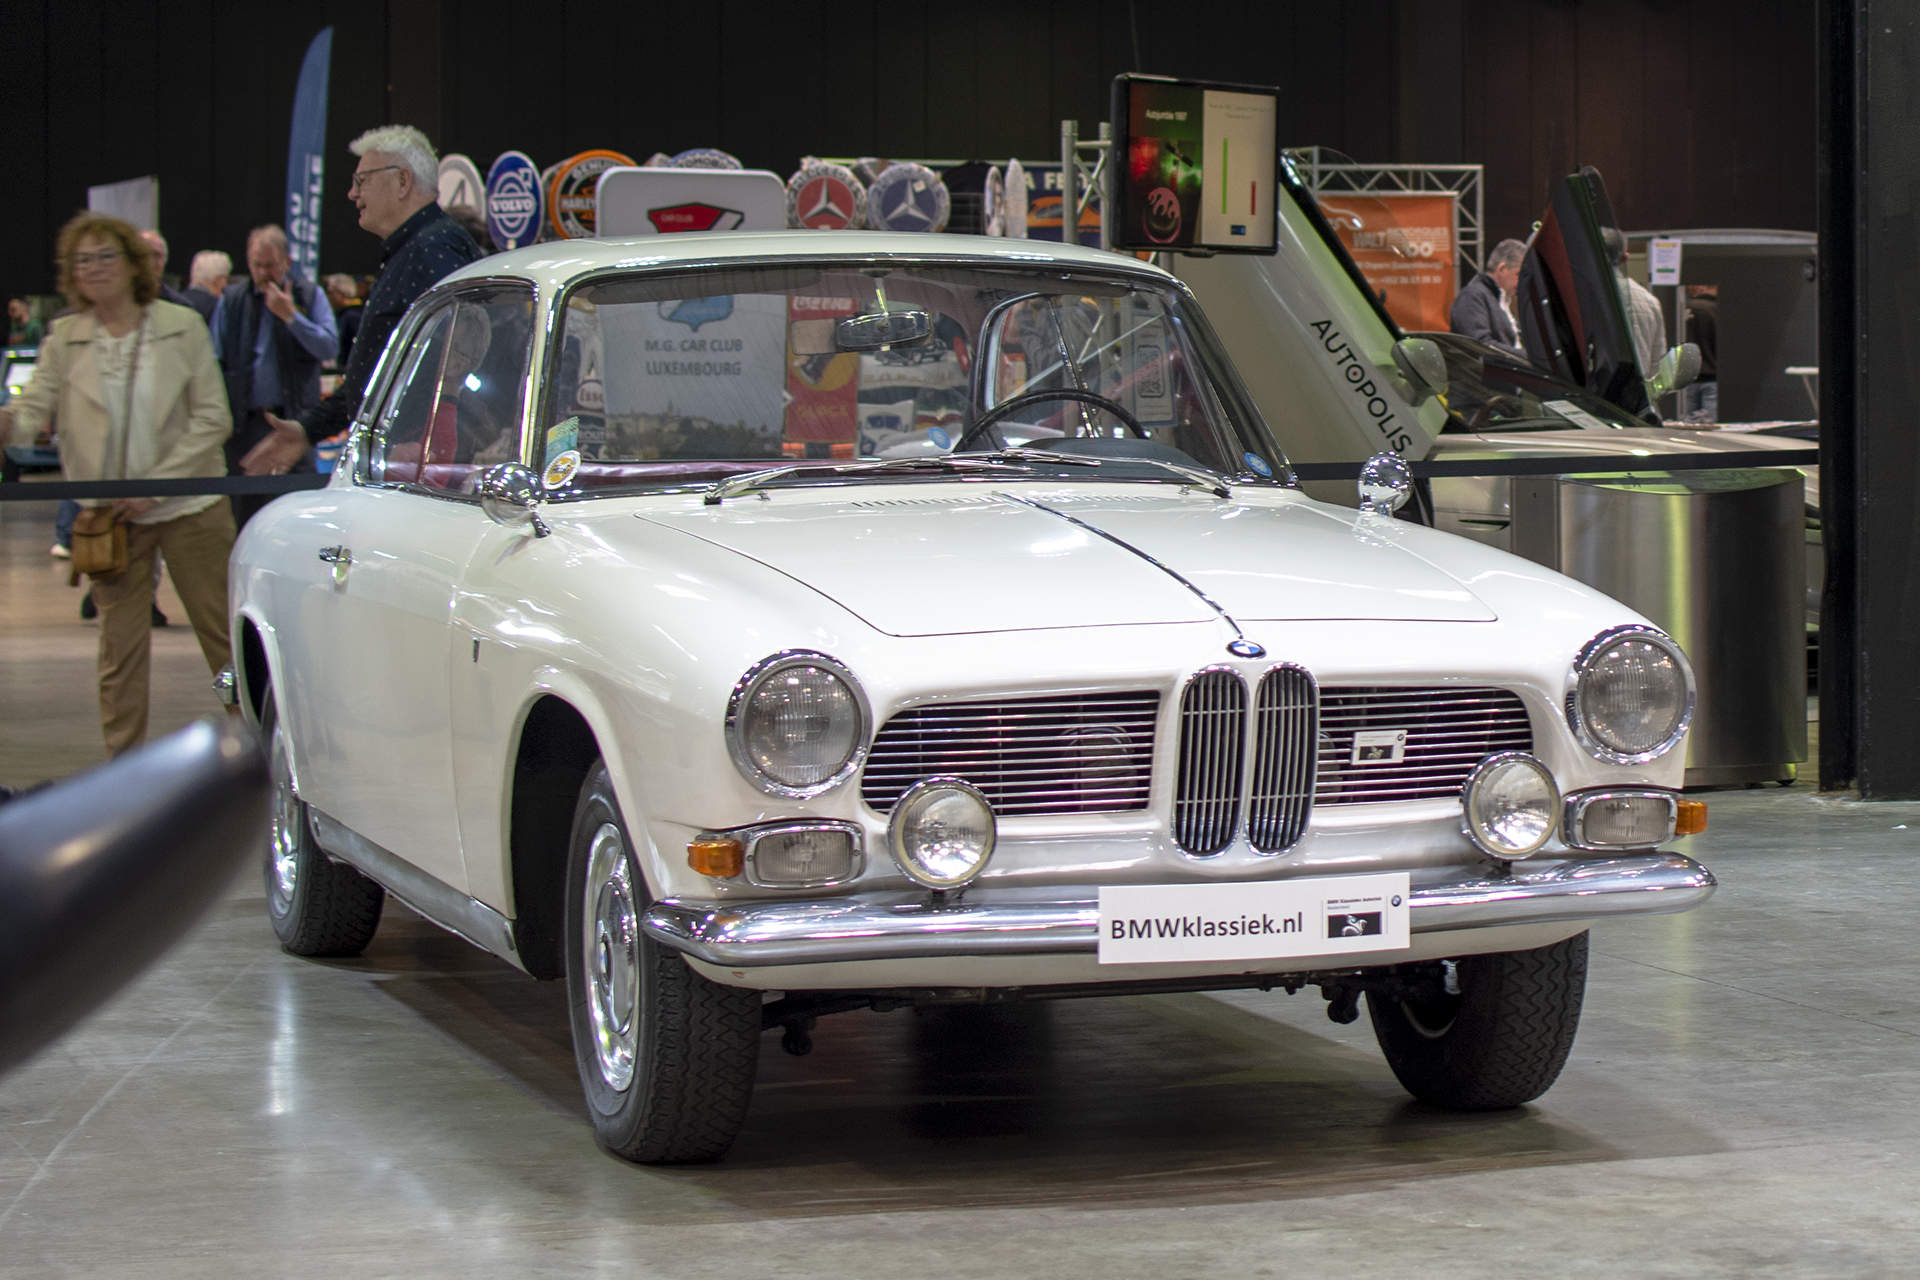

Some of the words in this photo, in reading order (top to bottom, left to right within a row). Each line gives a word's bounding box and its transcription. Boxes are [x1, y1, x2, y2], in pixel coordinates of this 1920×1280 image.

[491, 199, 533, 212] VOLVO
[645, 339, 676, 352] M.G.
[679, 339, 707, 352] CAR
[710, 339, 743, 352] CLUB
[645, 361, 742, 376] LUXEMBOURG
[1310, 319, 1413, 453] AUTOPOLIS
[1110, 911, 1303, 940] BMWklassiek.nl
